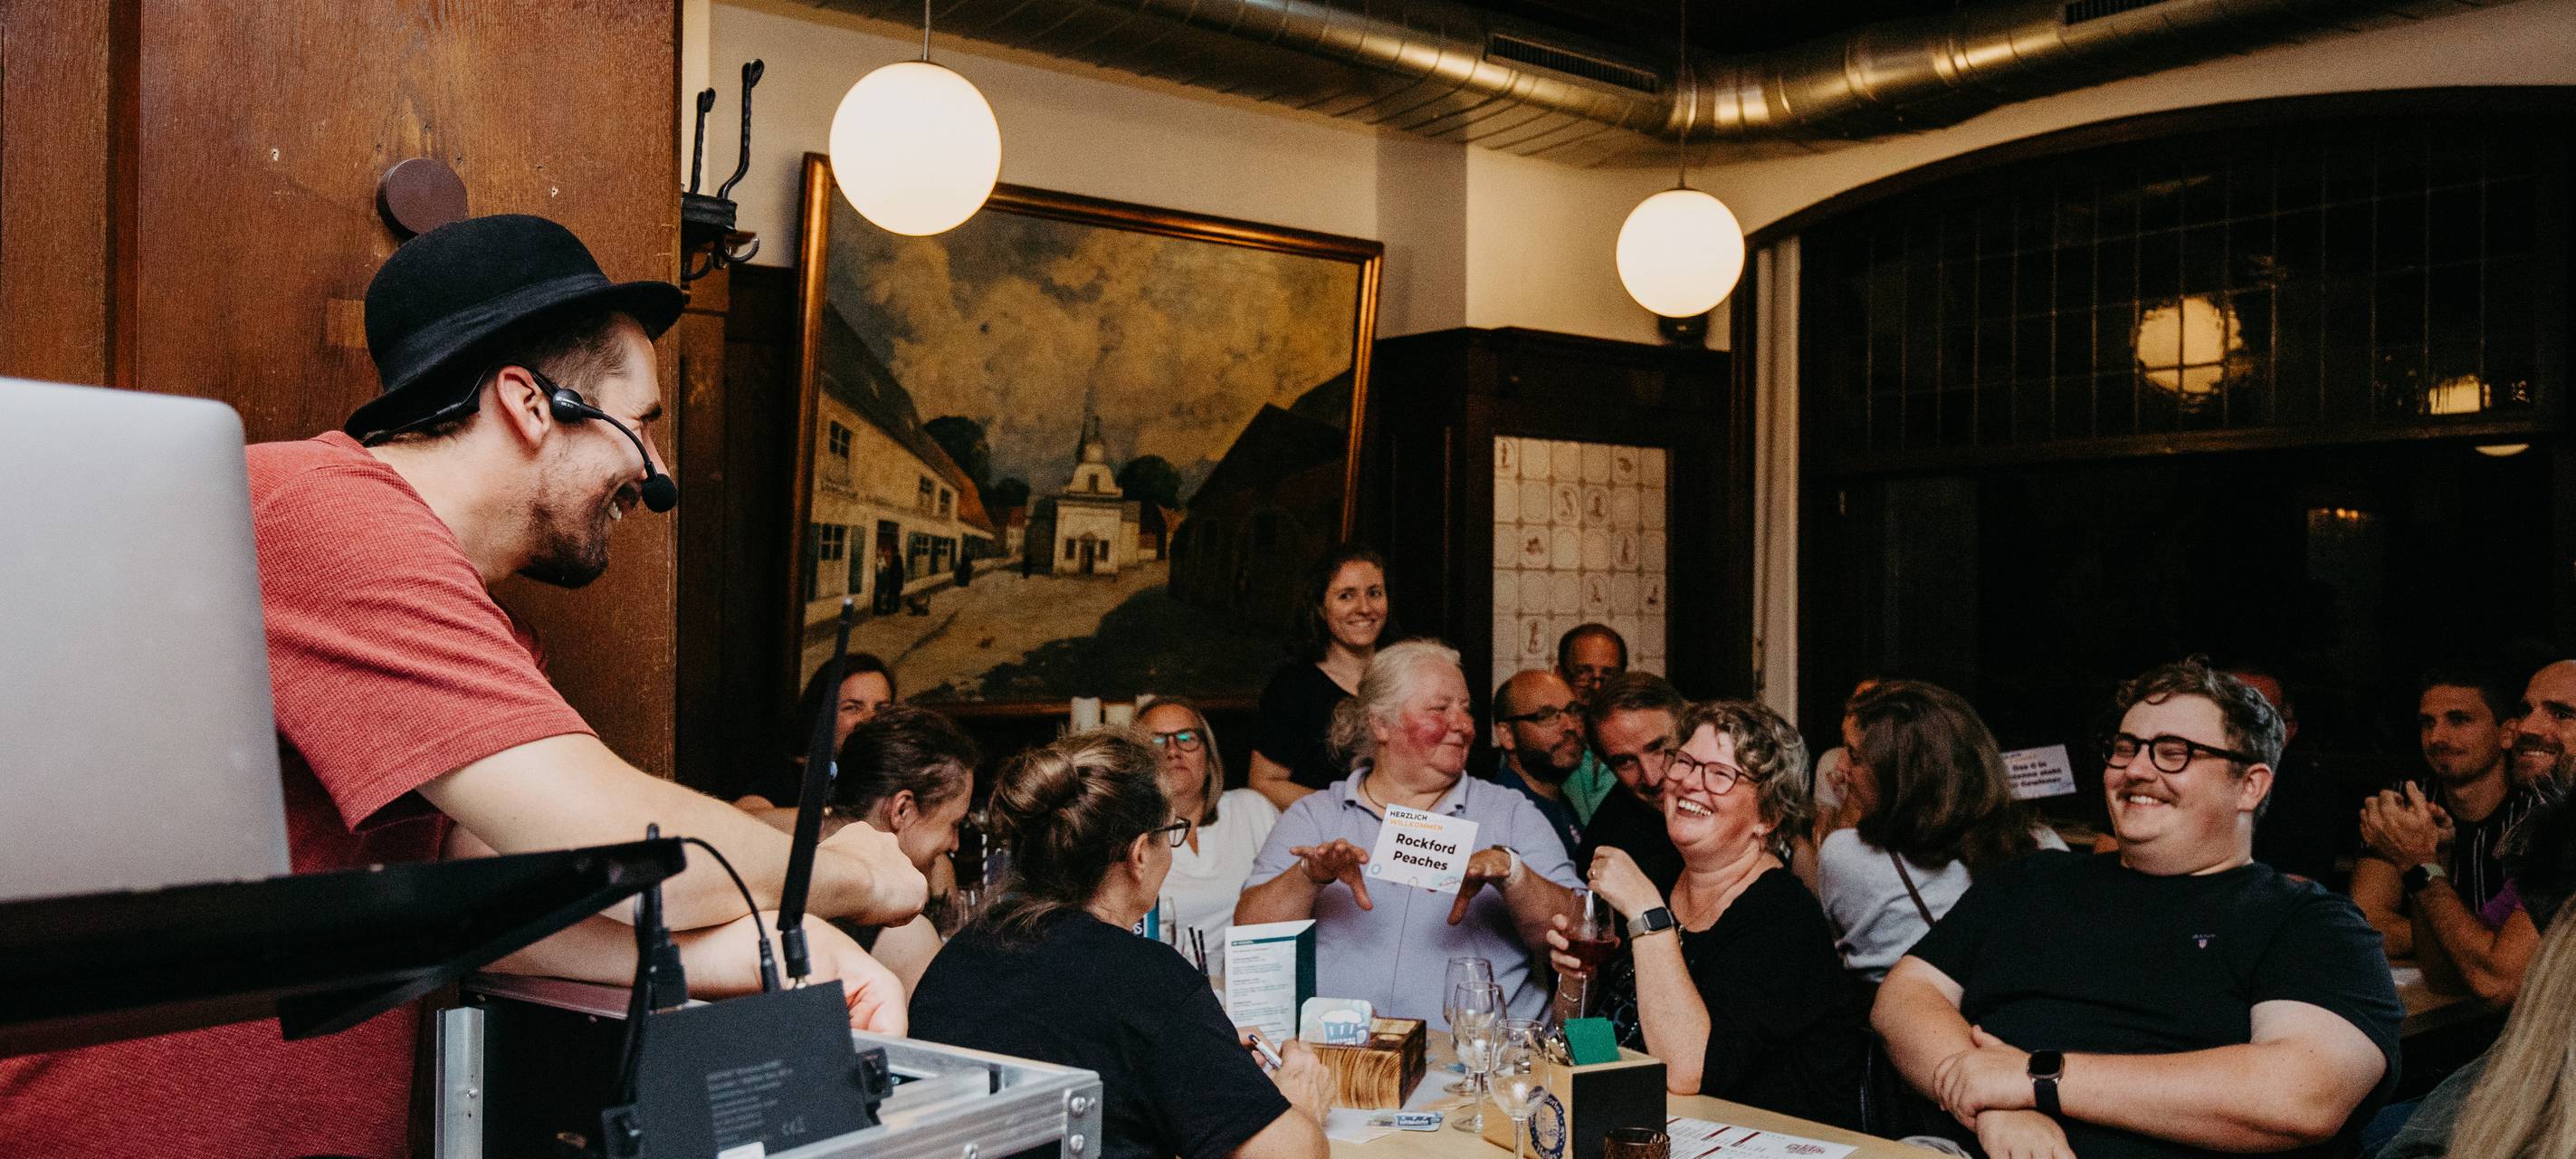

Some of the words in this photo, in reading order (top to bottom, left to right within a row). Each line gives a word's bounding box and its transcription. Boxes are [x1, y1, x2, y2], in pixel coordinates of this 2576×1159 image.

[1389, 810, 1427, 821] HERZLICH
[1389, 819, 1444, 831] WILLKOMMEN
[1395, 833, 1456, 855] Rockford
[1393, 851, 1448, 870] Peaches
